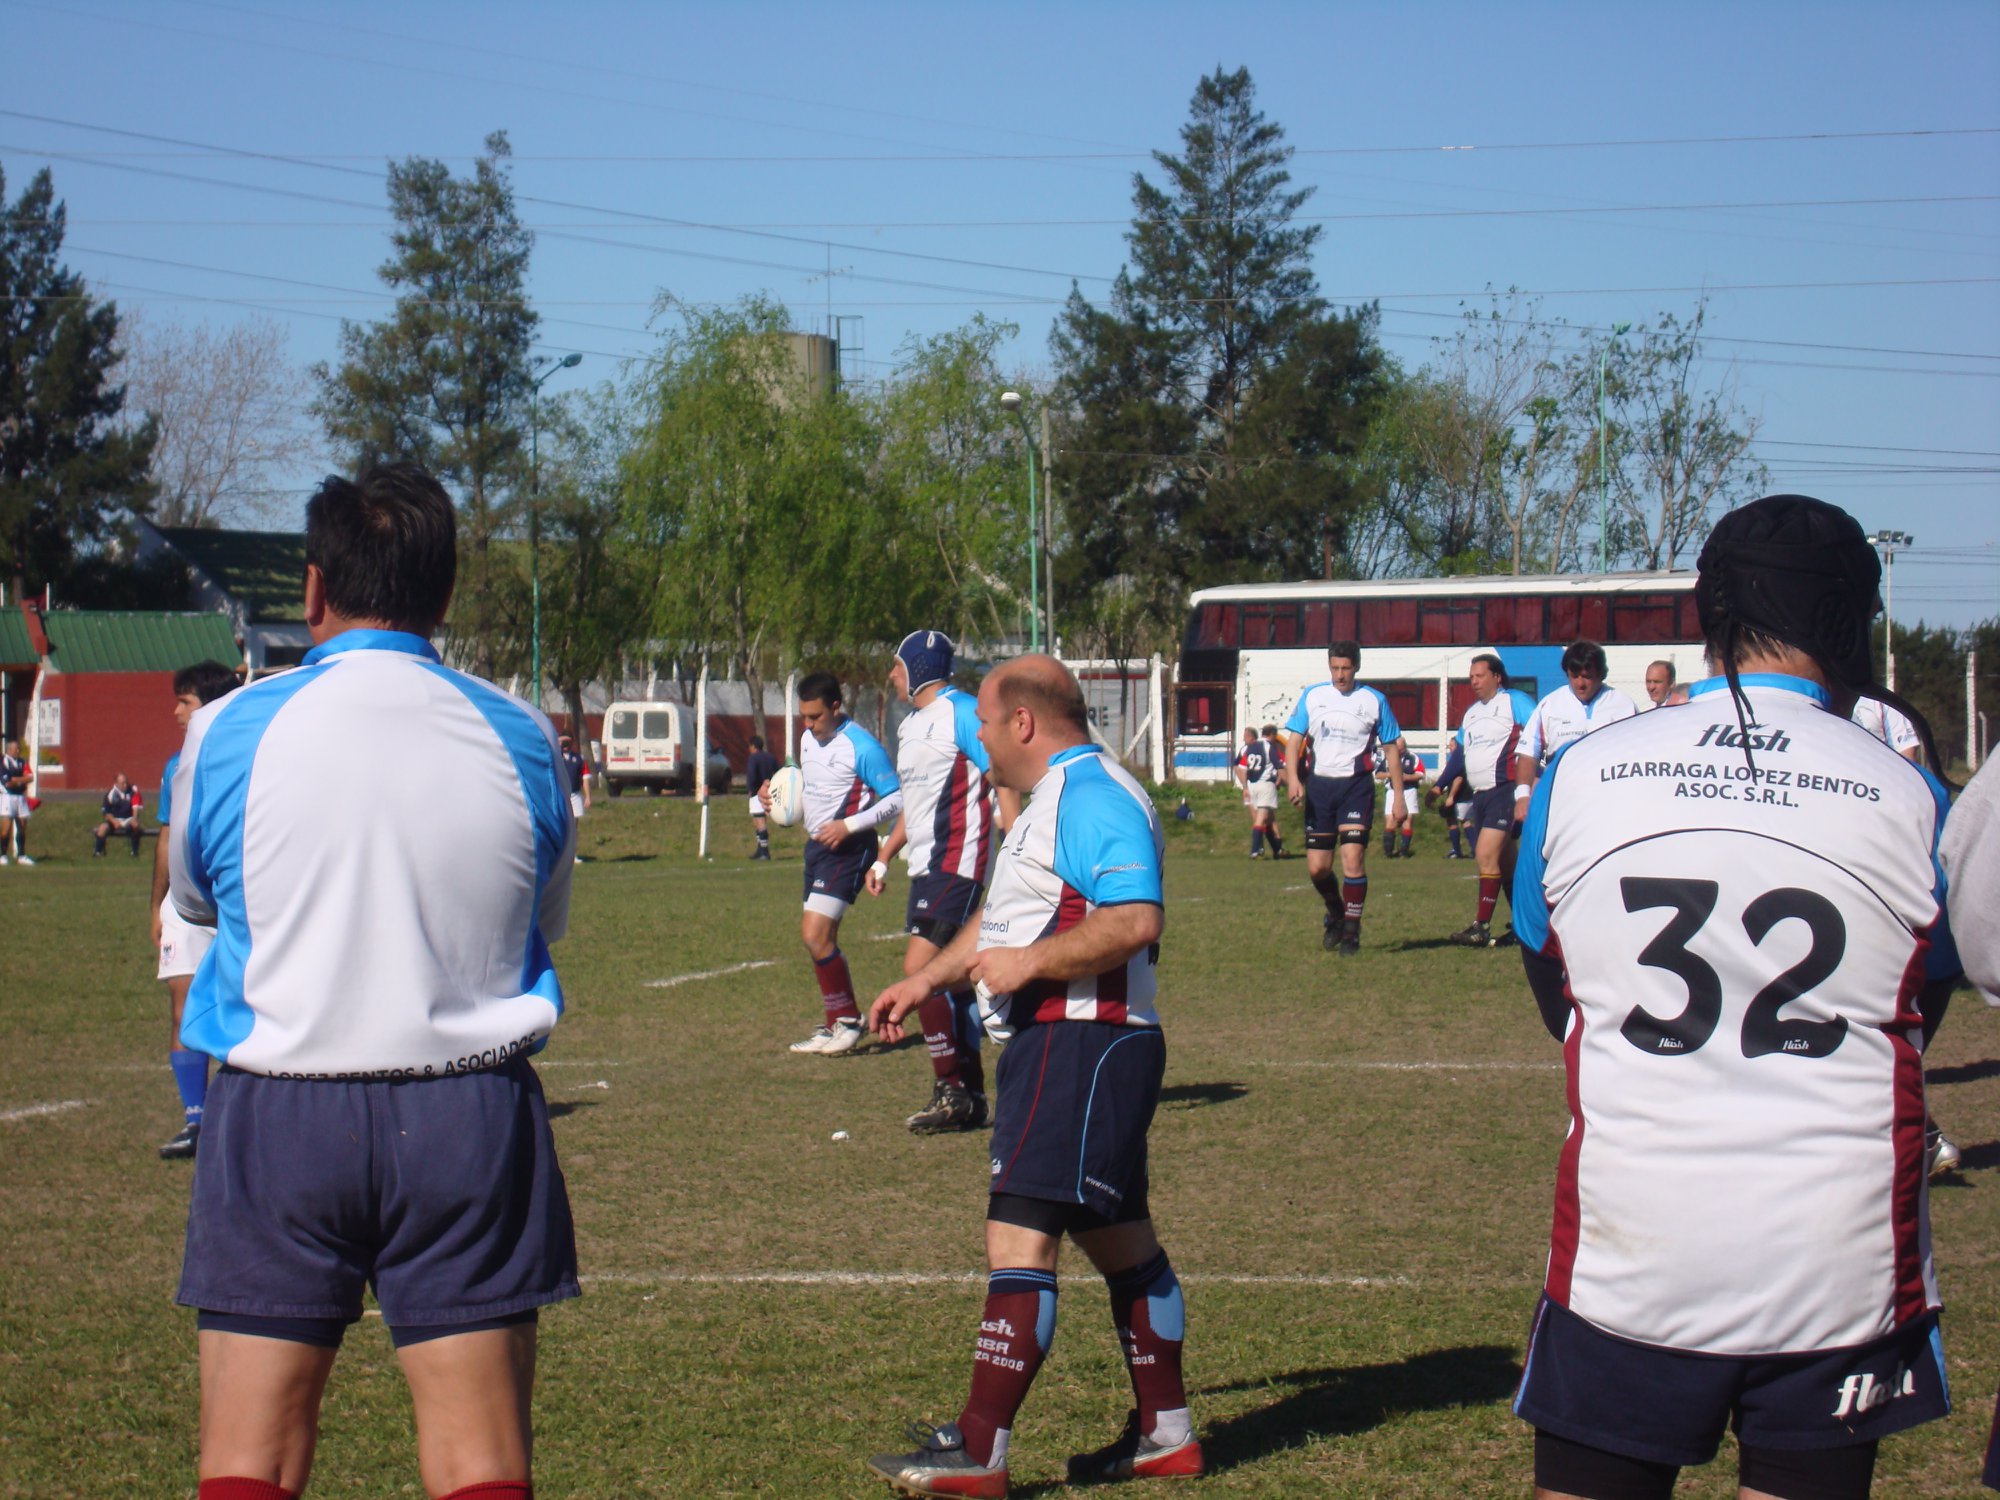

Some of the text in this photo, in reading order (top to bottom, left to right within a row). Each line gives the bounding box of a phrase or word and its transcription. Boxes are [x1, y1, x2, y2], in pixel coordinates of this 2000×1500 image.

[1693, 723, 1791, 753] flash
[1247, 752, 1263, 771] 92
[1600, 761, 1881, 802] LIZARRAGA LOPEZ BENTOS
[1674, 782, 1800, 808] ASOC. S.R.L.
[1619, 876, 1849, 1059] 32
[424, 1064, 435, 1077] &
[991, 1354, 1025, 1372] 2008
